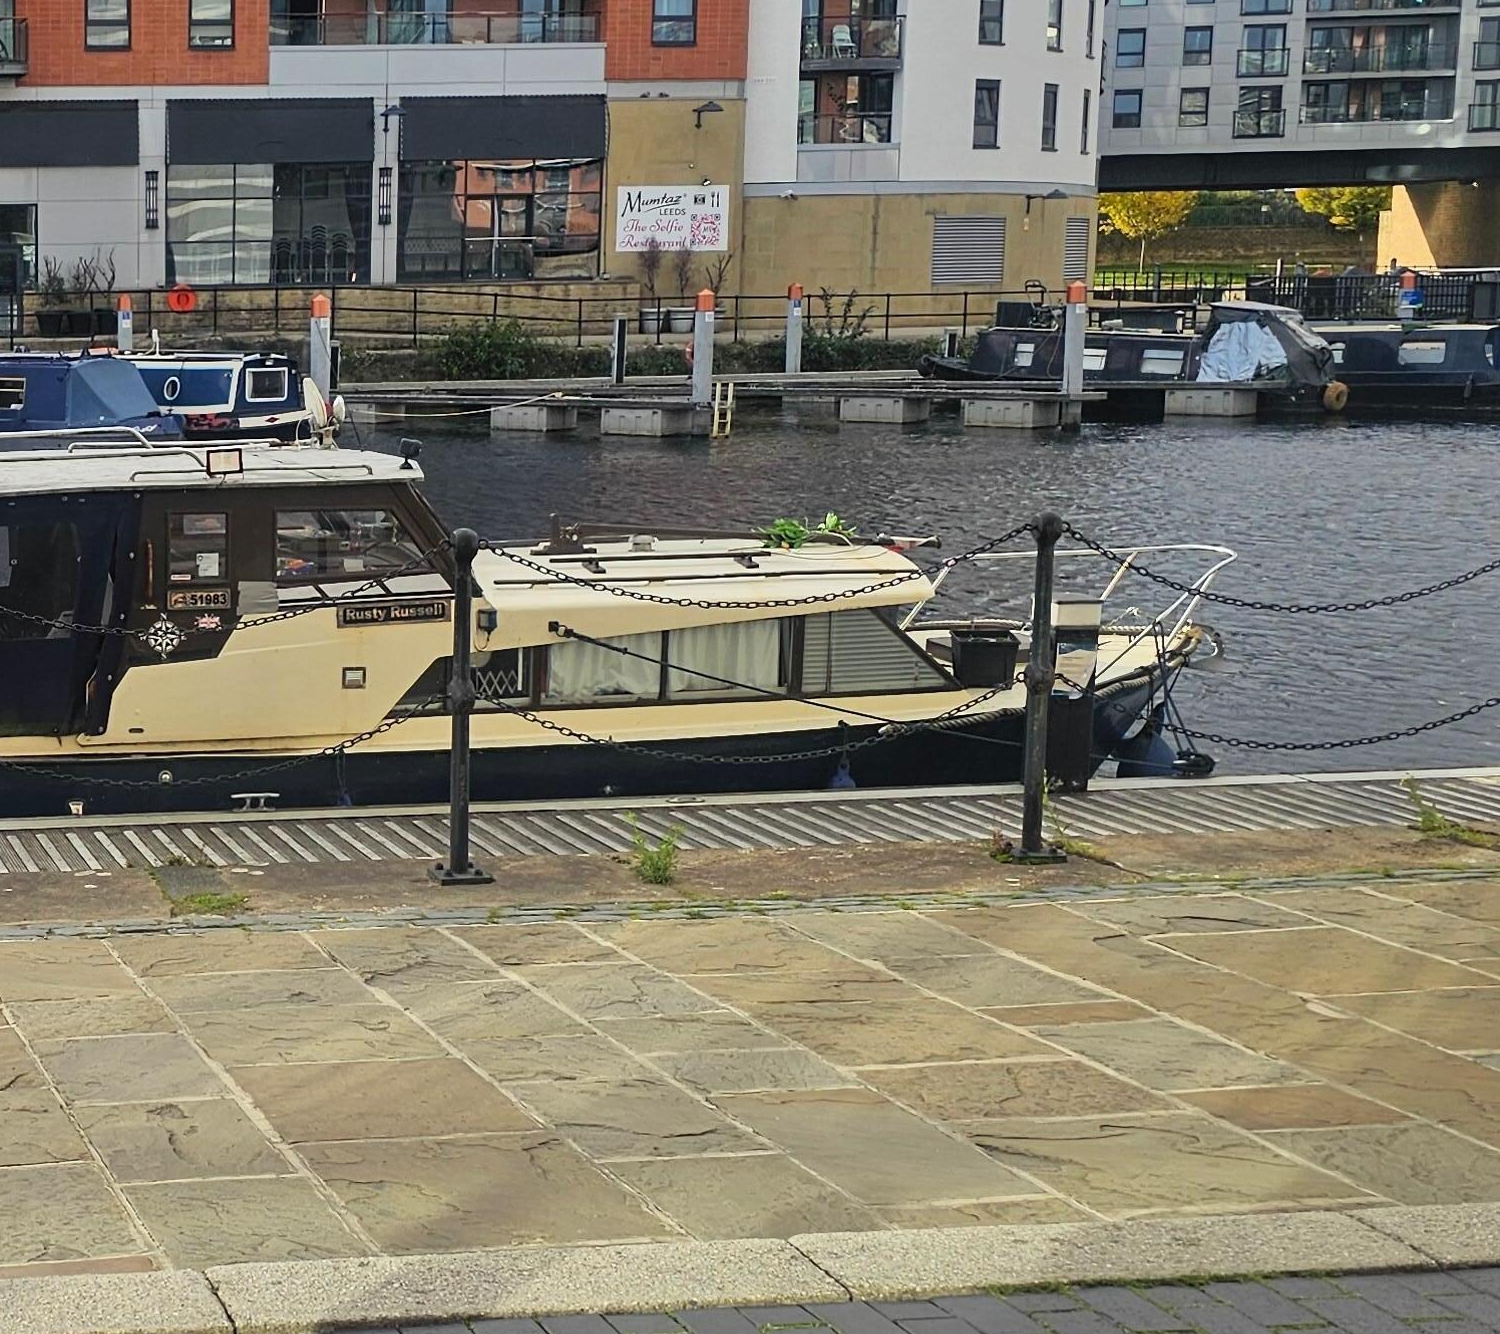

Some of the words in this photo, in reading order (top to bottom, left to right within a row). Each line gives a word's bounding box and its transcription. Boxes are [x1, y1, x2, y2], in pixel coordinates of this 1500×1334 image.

[659, 208, 686, 216] LEEDS
[623, 218, 647, 233] The
[649, 218, 684, 234] Selfie
[190, 593, 227, 605] 51983
[346, 607, 386, 621] Rusty
[390, 603, 442, 618] Russell
